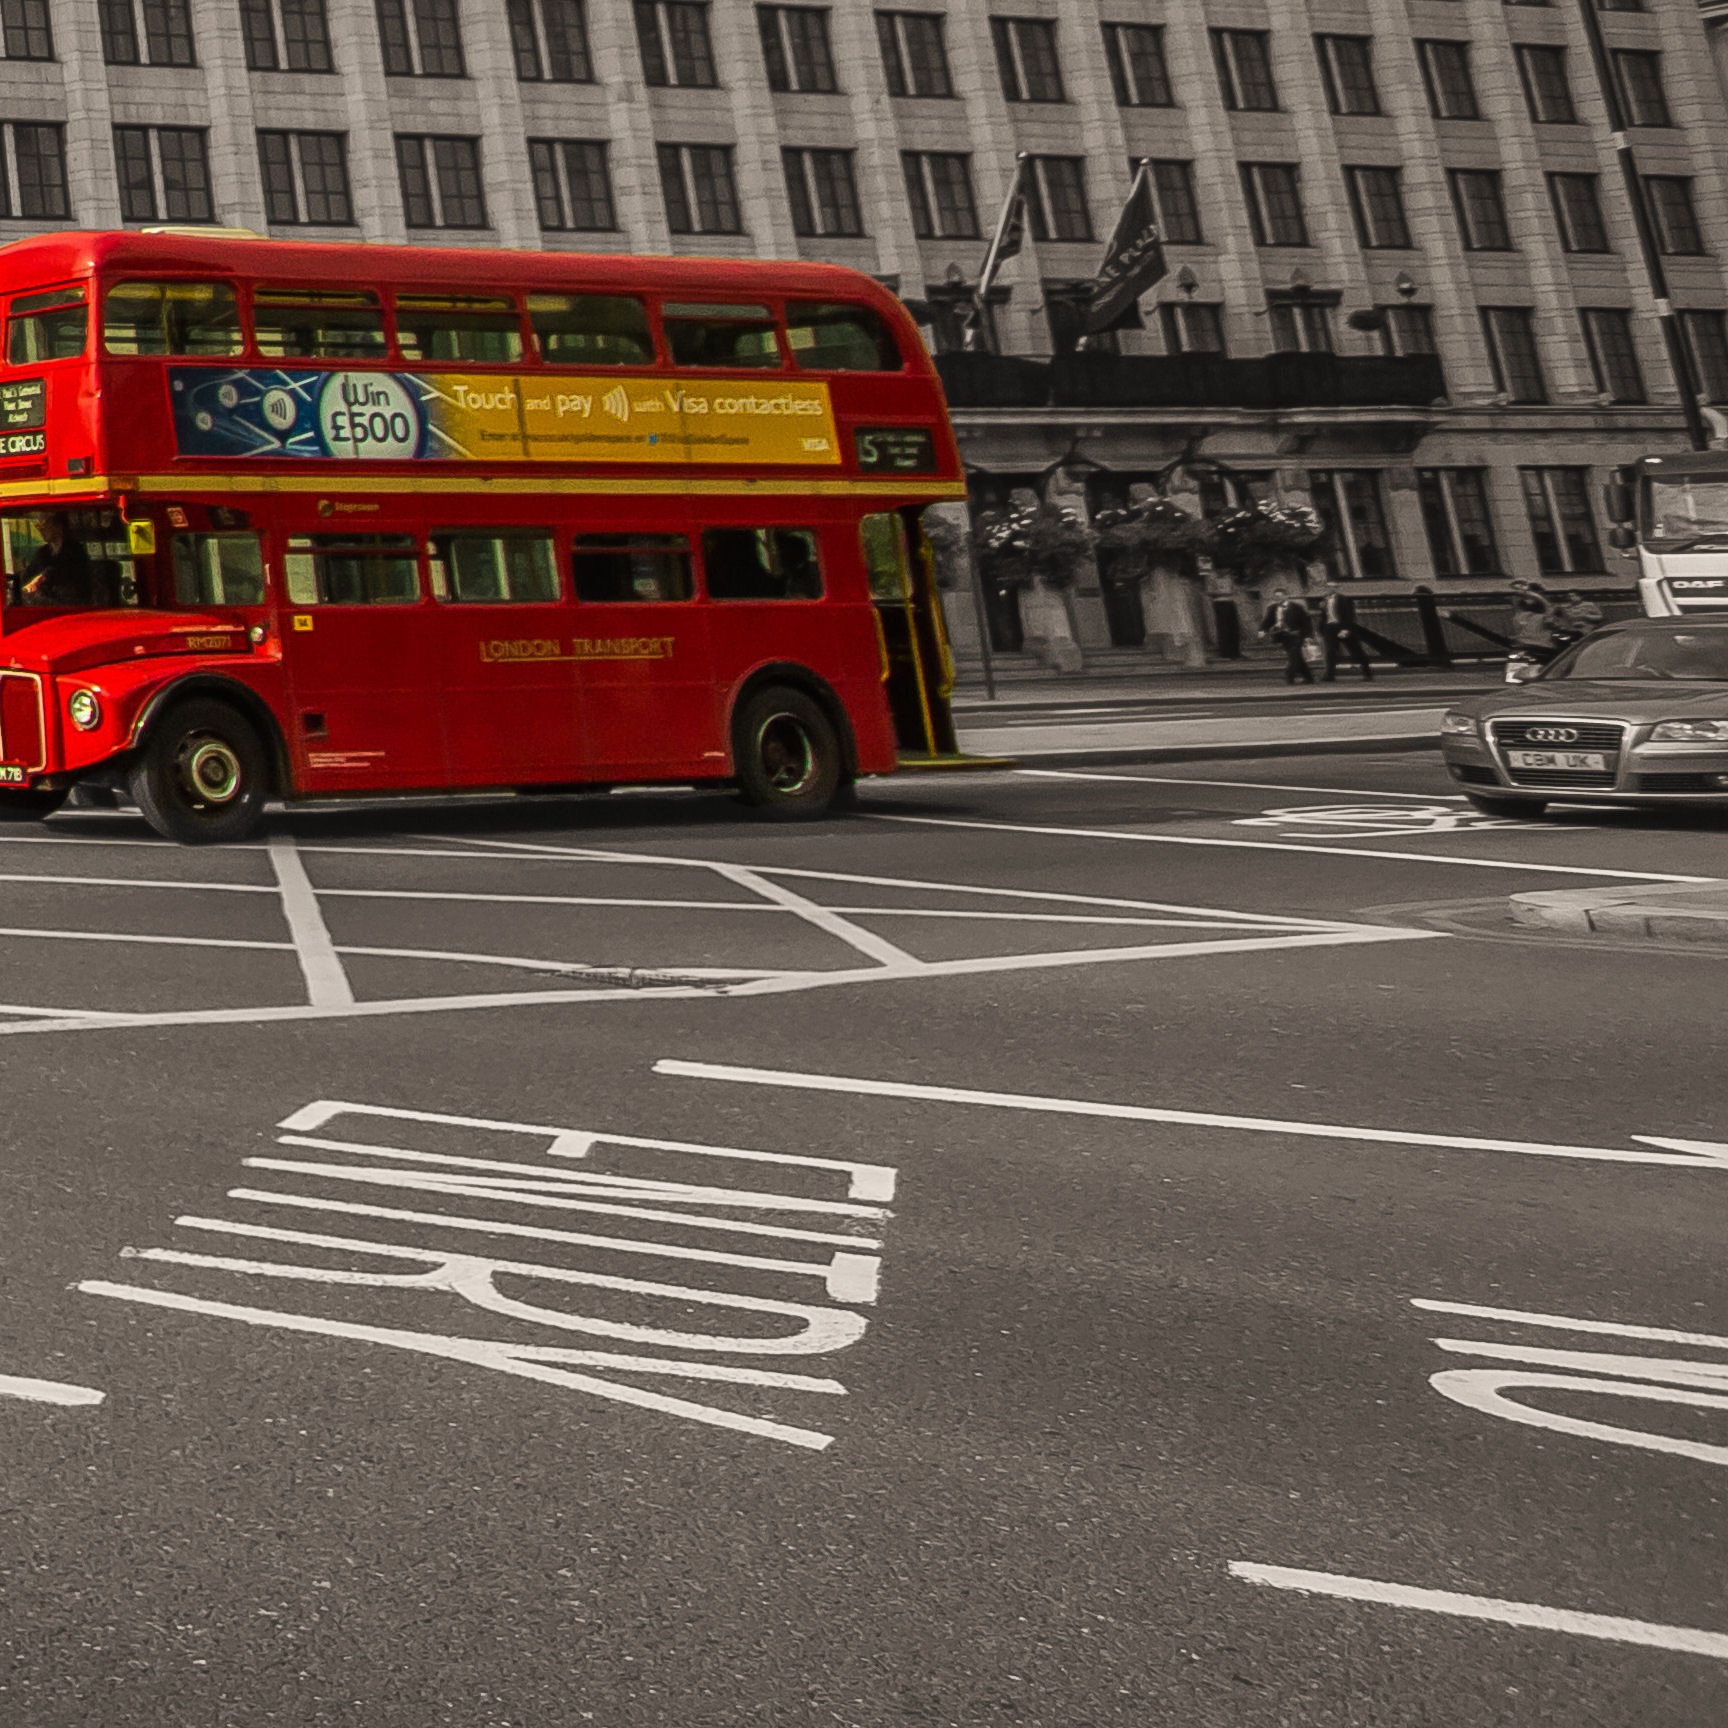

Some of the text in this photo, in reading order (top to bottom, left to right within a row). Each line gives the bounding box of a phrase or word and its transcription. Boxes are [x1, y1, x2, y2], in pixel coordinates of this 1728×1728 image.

[341, 380, 391, 408] Win
[452, 385, 518, 410] Touch
[526, 398, 551, 411] and
[557, 393, 593, 419] pay
[664, 390, 709, 415] Visa
[715, 394, 824, 416] contactless
[331, 410, 411, 443] £500
[8, 433, 45, 453] CIRCUS
[1672, 580, 1724, 589] DAF
[479, 636, 676, 663] LONDON TRANSPORT
[76, 1099, 899, 1451] ENTRY
